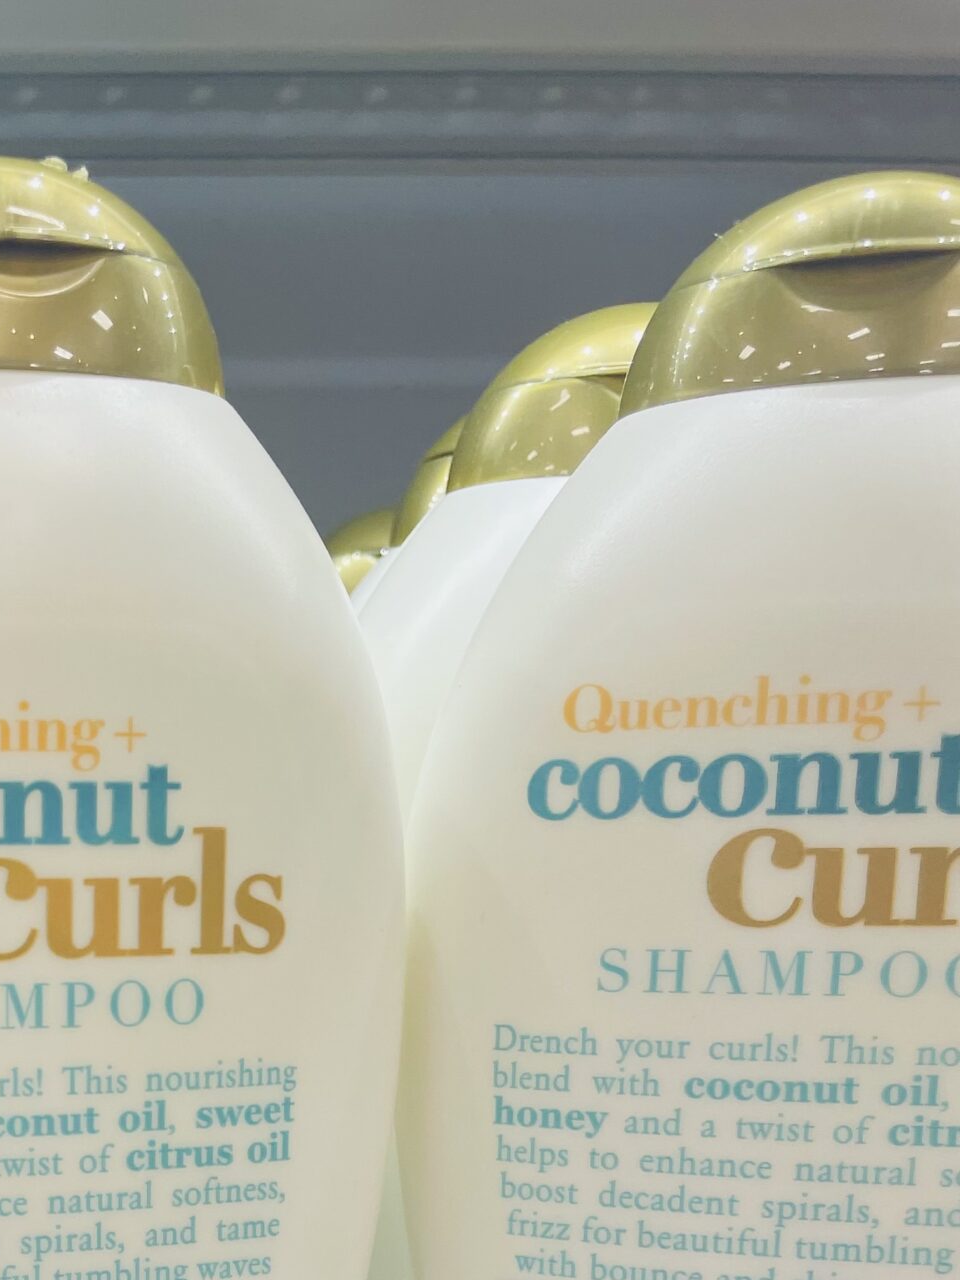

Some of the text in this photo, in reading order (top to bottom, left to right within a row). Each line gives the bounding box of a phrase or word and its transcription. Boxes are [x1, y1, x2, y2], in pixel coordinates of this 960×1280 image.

[62, 1064, 128, 1097] This
[145, 1058, 298, 1093] nourishing
[118, 1100, 177, 1135] oil,
[195, 1096, 294, 1129] sweet
[79, 1144, 114, 1175] of
[126, 1136, 233, 1173] citrus
[247, 1130, 290, 1164] oil
[48, 1181, 153, 1216] natural
[171, 1177, 286, 1210] softness,
[20, 1224, 126, 1262] spirals,
[145, 1216, 197, 1248] and
[217, 1215, 280, 1243] tame
[198, 1255, 272, 1280] waves
